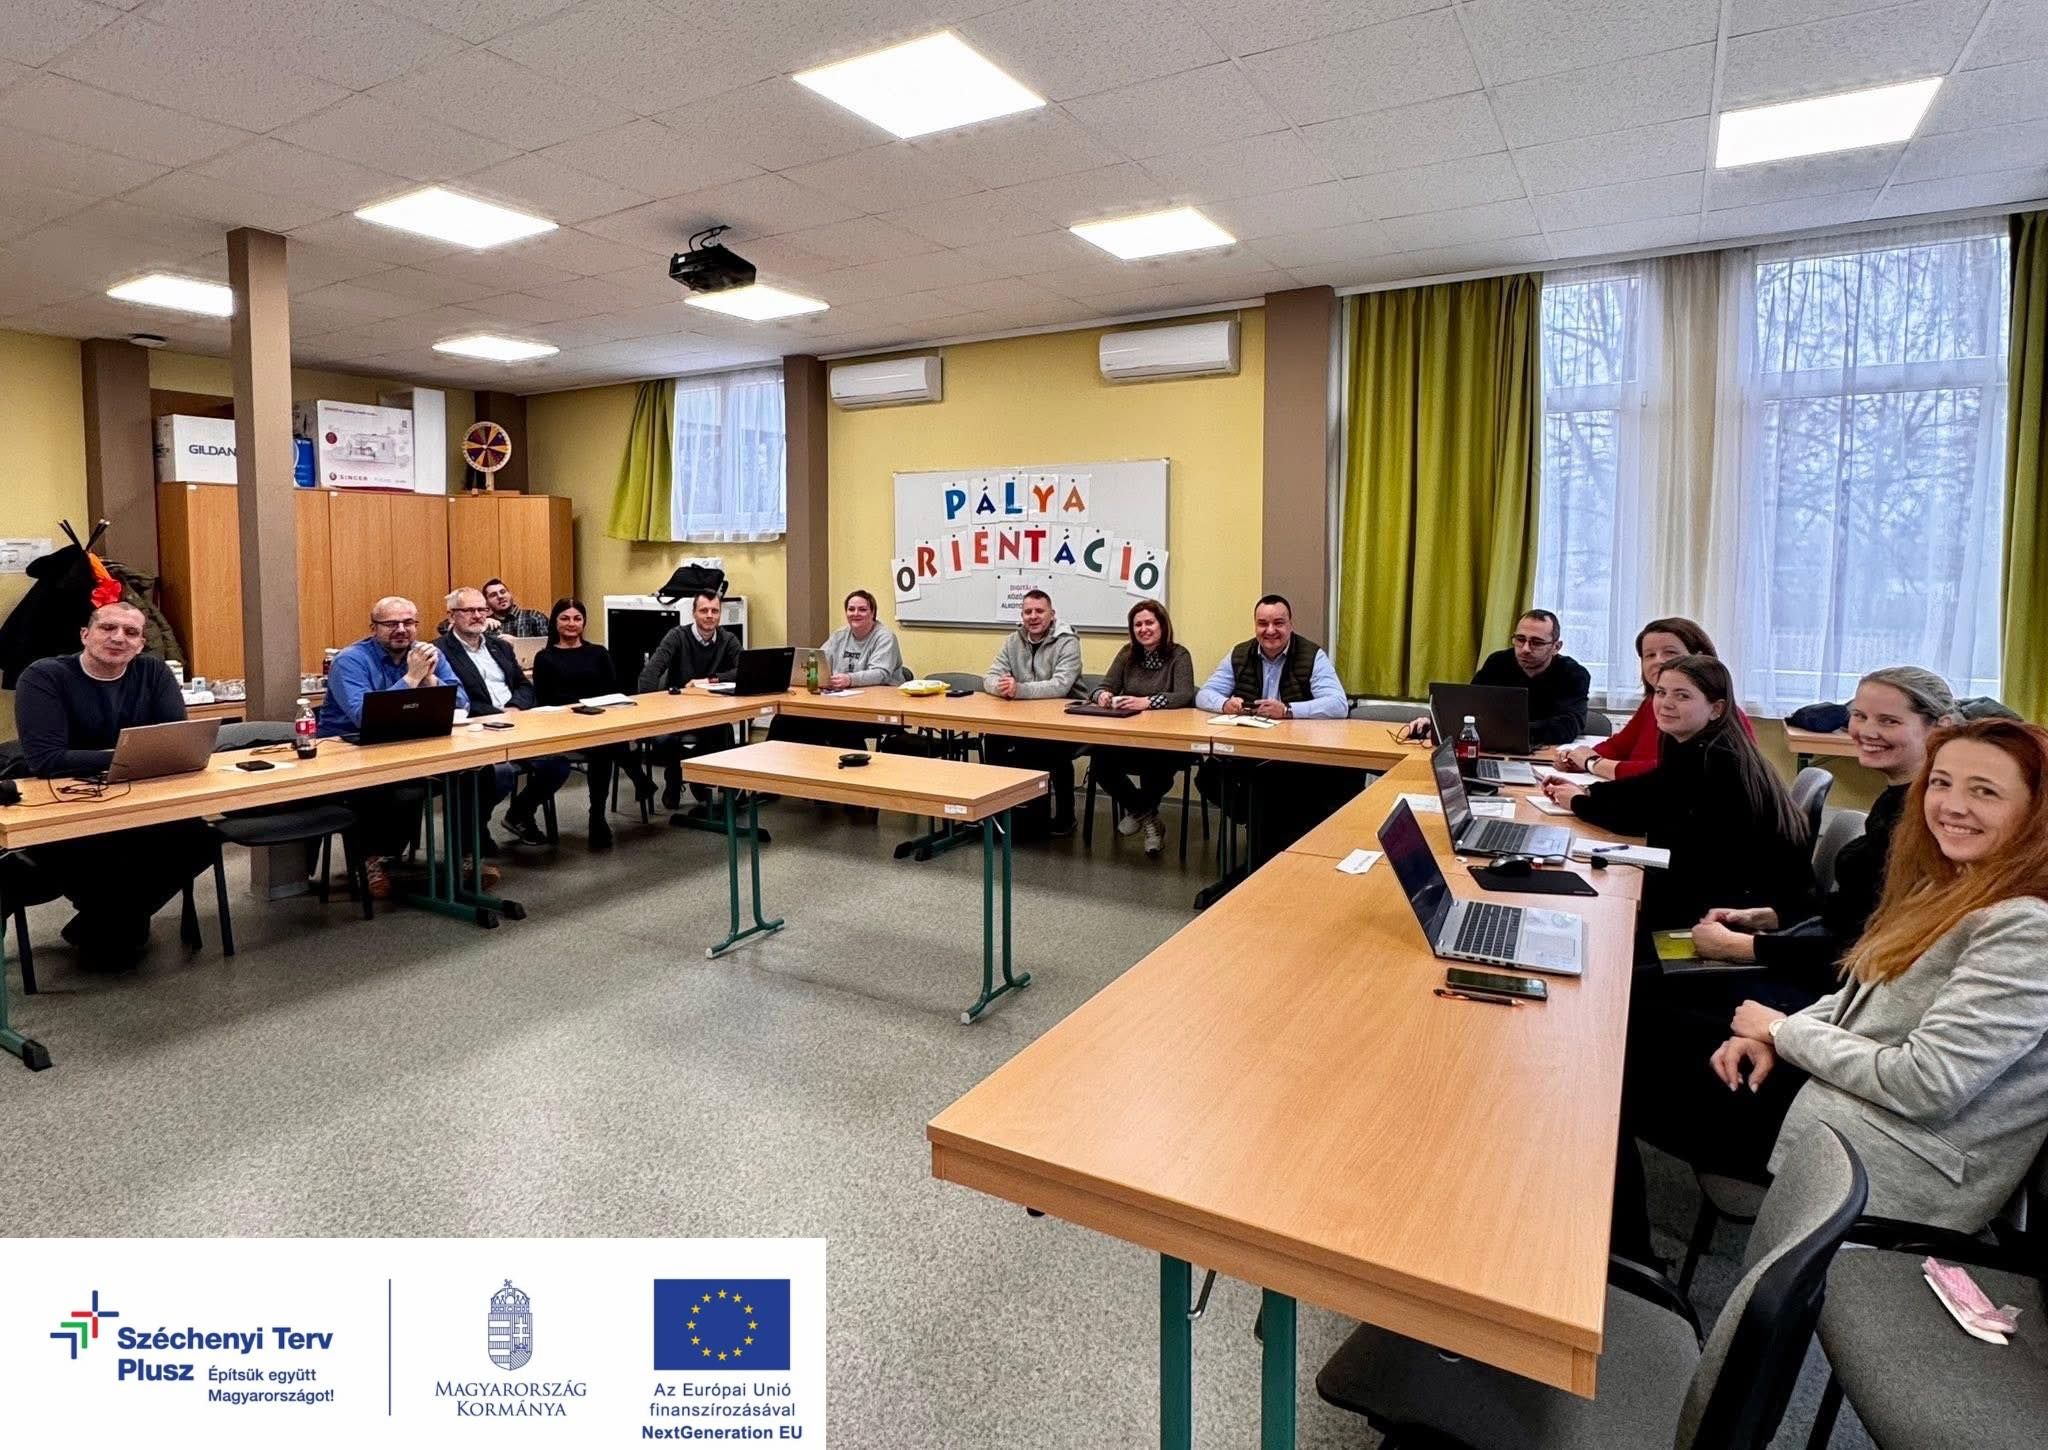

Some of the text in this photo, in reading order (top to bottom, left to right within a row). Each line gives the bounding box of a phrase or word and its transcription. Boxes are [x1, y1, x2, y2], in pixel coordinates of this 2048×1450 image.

[188, 444, 237, 457] GILDAN
[945, 482, 1086, 520] PÁLYA
[896, 530, 1159, 592] ORIENTÁCIÓ
